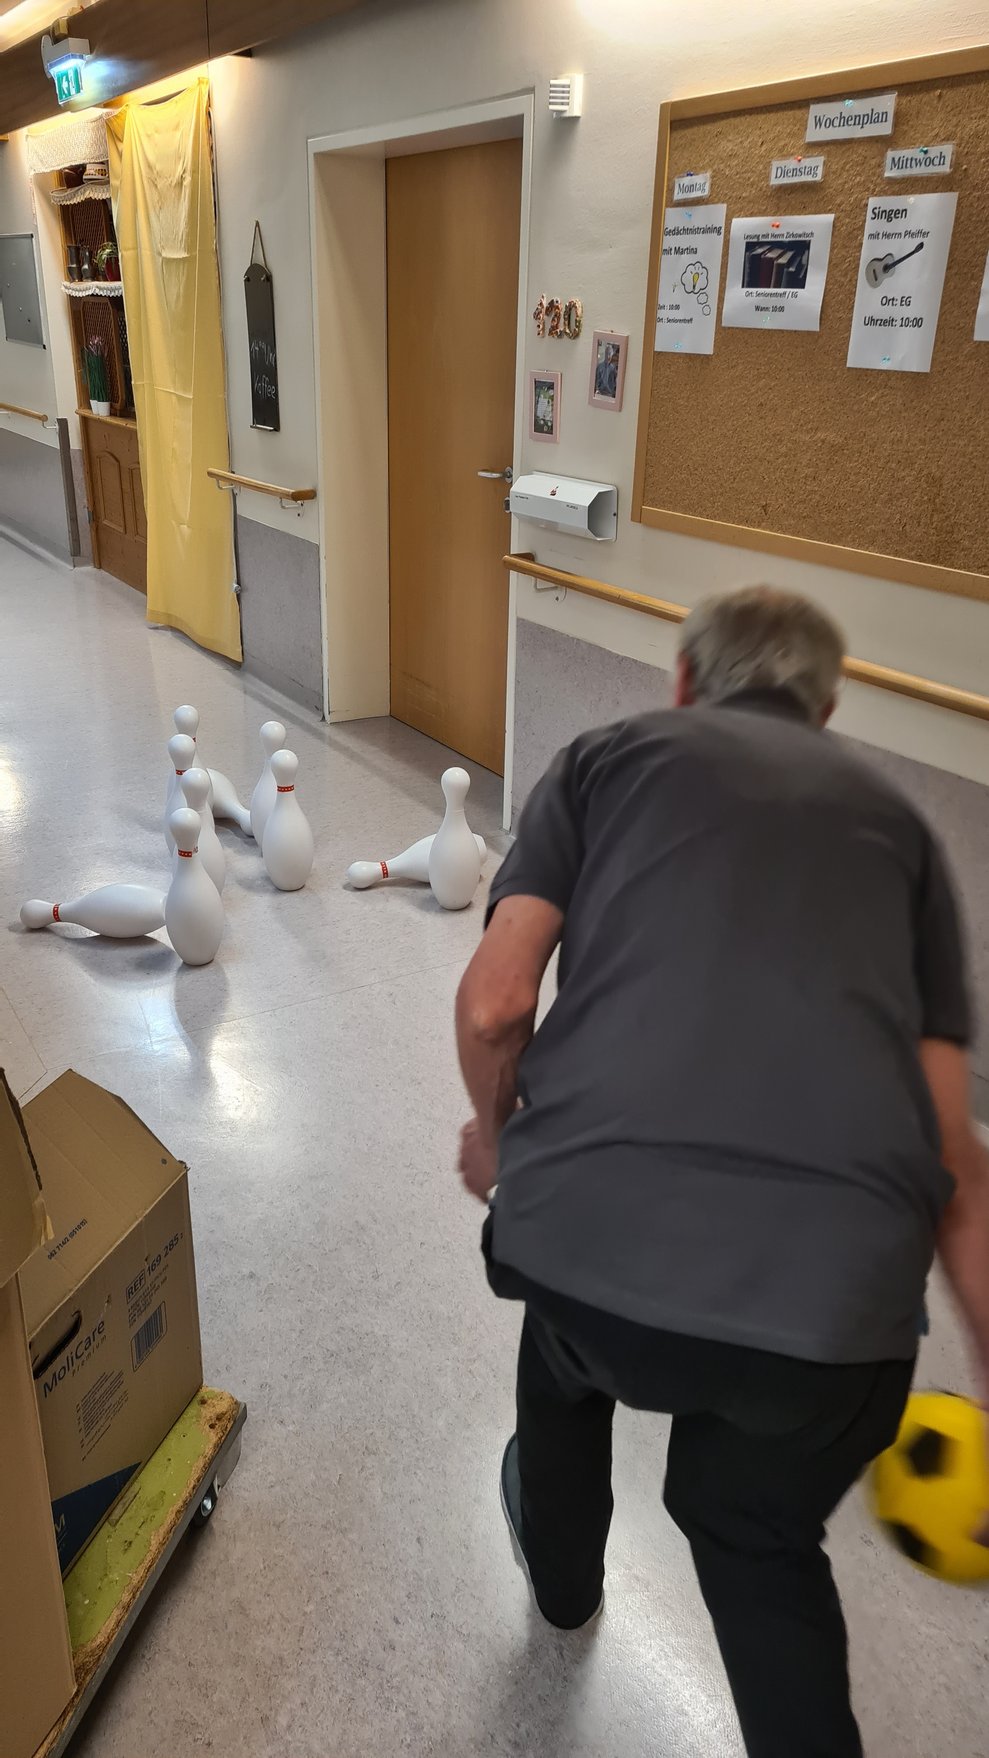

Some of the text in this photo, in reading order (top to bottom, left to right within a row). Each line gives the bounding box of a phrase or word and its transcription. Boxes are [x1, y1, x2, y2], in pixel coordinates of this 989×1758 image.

[813, 108, 889, 130] Wochenplan
[889, 151, 946, 171] Mittwoch
[774, 164, 819, 180] Dienstag
[676, 181, 707, 196] Montag
[870, 206, 908, 223] Singen
[663, 224, 723, 237] Gedächtnistraining
[743, 233, 760, 241] Lesung
[868, 228, 930, 240] mit Herrn Pfeiffer
[662, 245, 698, 256] mit Martina
[744, 290, 754, 298] Ort:
[755, 290, 787, 298] Seniorentreff
[880, 295, 912, 307] Ort: EG
[532, 293, 583, 340] 120
[863, 315, 924, 328] Uhrzeit: 10:00
[127, 1272, 145, 1300] REF
[146, 1254, 162, 1276] 169
[43, 1319, 105, 1398] MoliCare
